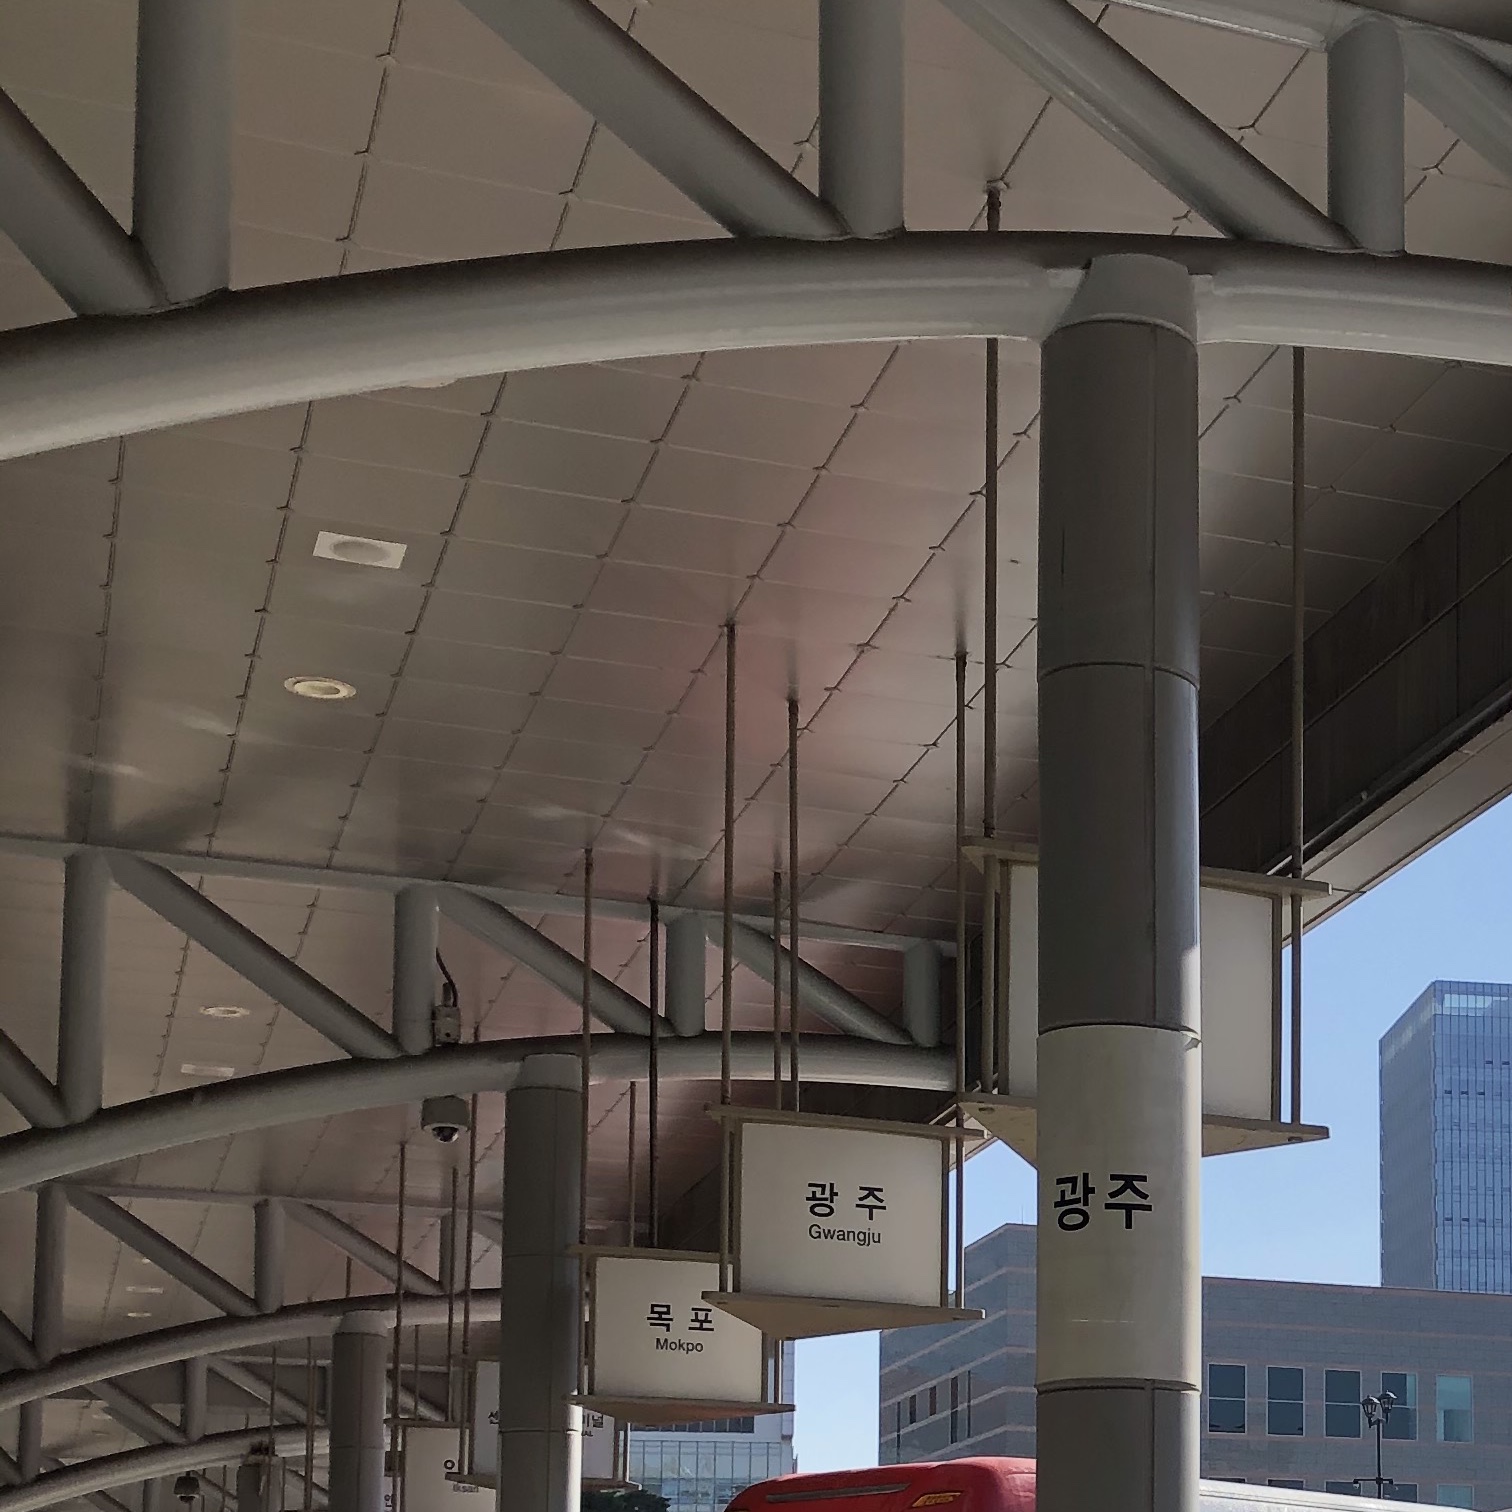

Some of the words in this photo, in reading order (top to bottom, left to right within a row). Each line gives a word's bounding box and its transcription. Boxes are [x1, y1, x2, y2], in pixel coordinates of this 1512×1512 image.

[805, 1181, 888, 1222] 광주
[1053, 1172, 1154, 1232] 광주
[807, 1223, 882, 1248] Gwangju
[646, 1301, 715, 1334] 목포
[655, 1336, 704, 1355] Mokpo
